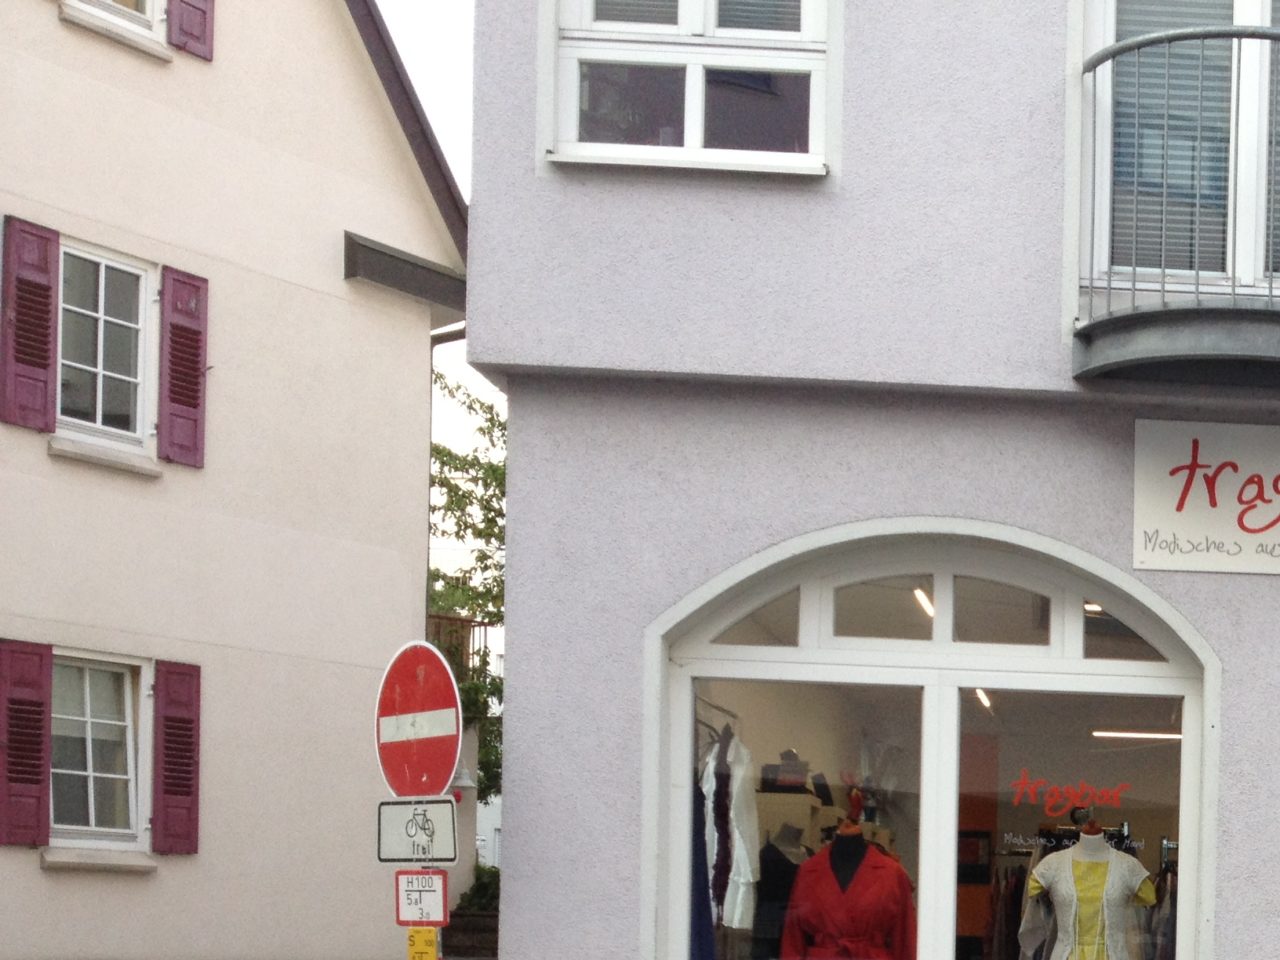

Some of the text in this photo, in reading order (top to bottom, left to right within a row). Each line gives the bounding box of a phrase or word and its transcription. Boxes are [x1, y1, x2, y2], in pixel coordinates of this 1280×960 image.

[1143, 529, 1242, 556] Modisches
[1010, 767, 1132, 817] tragbar
[412, 840, 431, 855] frei
[409, 934, 416, 947] S
